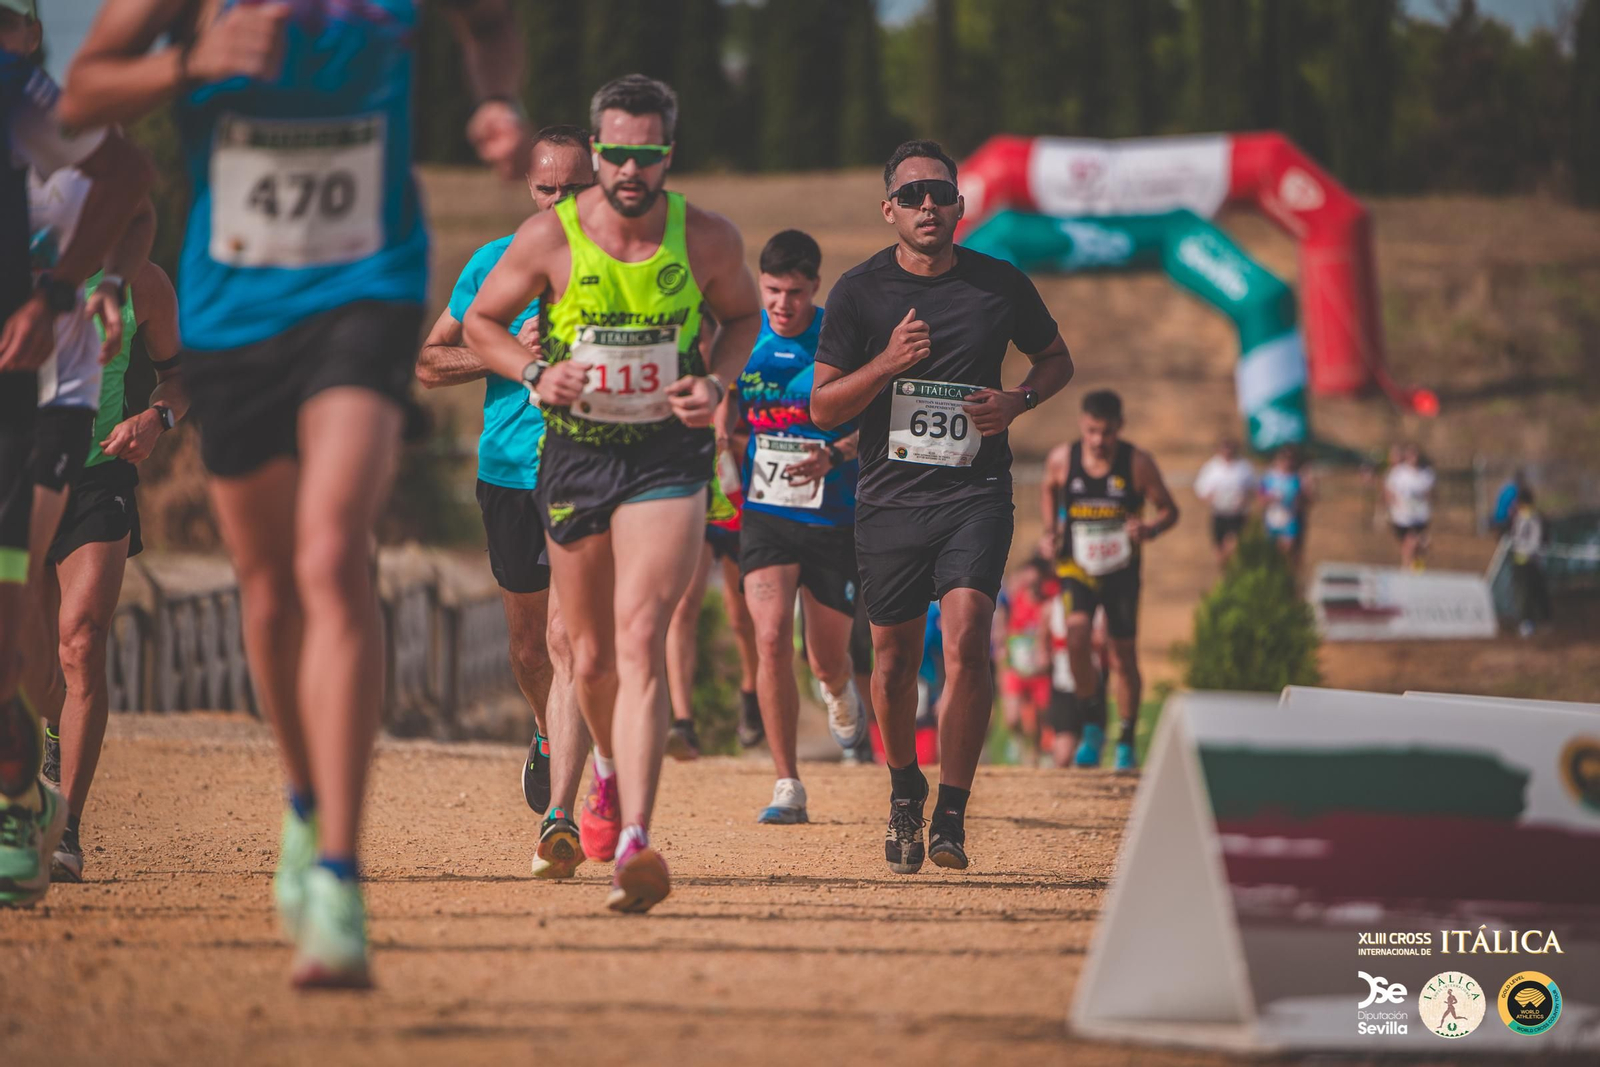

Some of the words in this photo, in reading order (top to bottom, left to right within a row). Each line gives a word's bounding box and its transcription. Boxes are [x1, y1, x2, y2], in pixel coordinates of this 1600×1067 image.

[247, 169, 356, 222] 470
[594, 362, 661, 395] 113
[909, 410, 968, 441] 630
